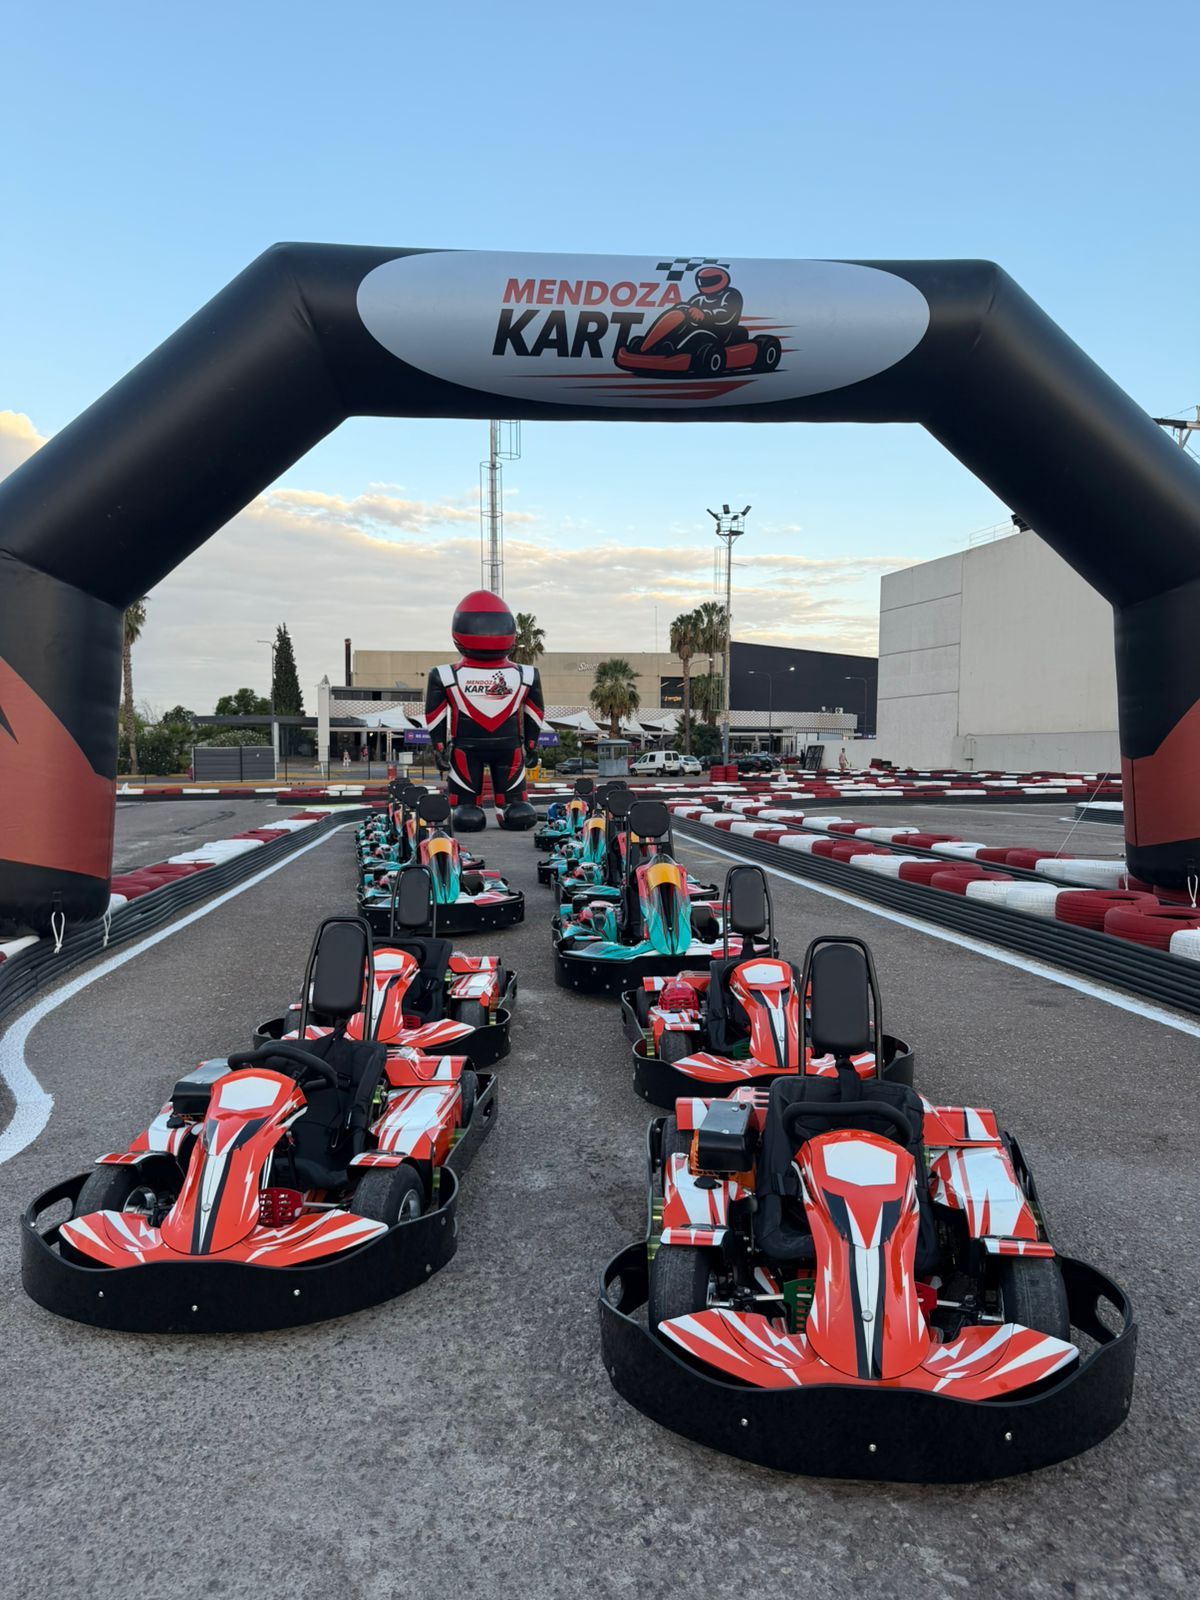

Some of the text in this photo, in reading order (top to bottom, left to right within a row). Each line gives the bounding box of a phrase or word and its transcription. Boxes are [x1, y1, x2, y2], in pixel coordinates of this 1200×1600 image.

[502, 278, 682, 307] MENDOZA
[492, 309, 645, 358] KART
[464, 685, 490, 693] KART
